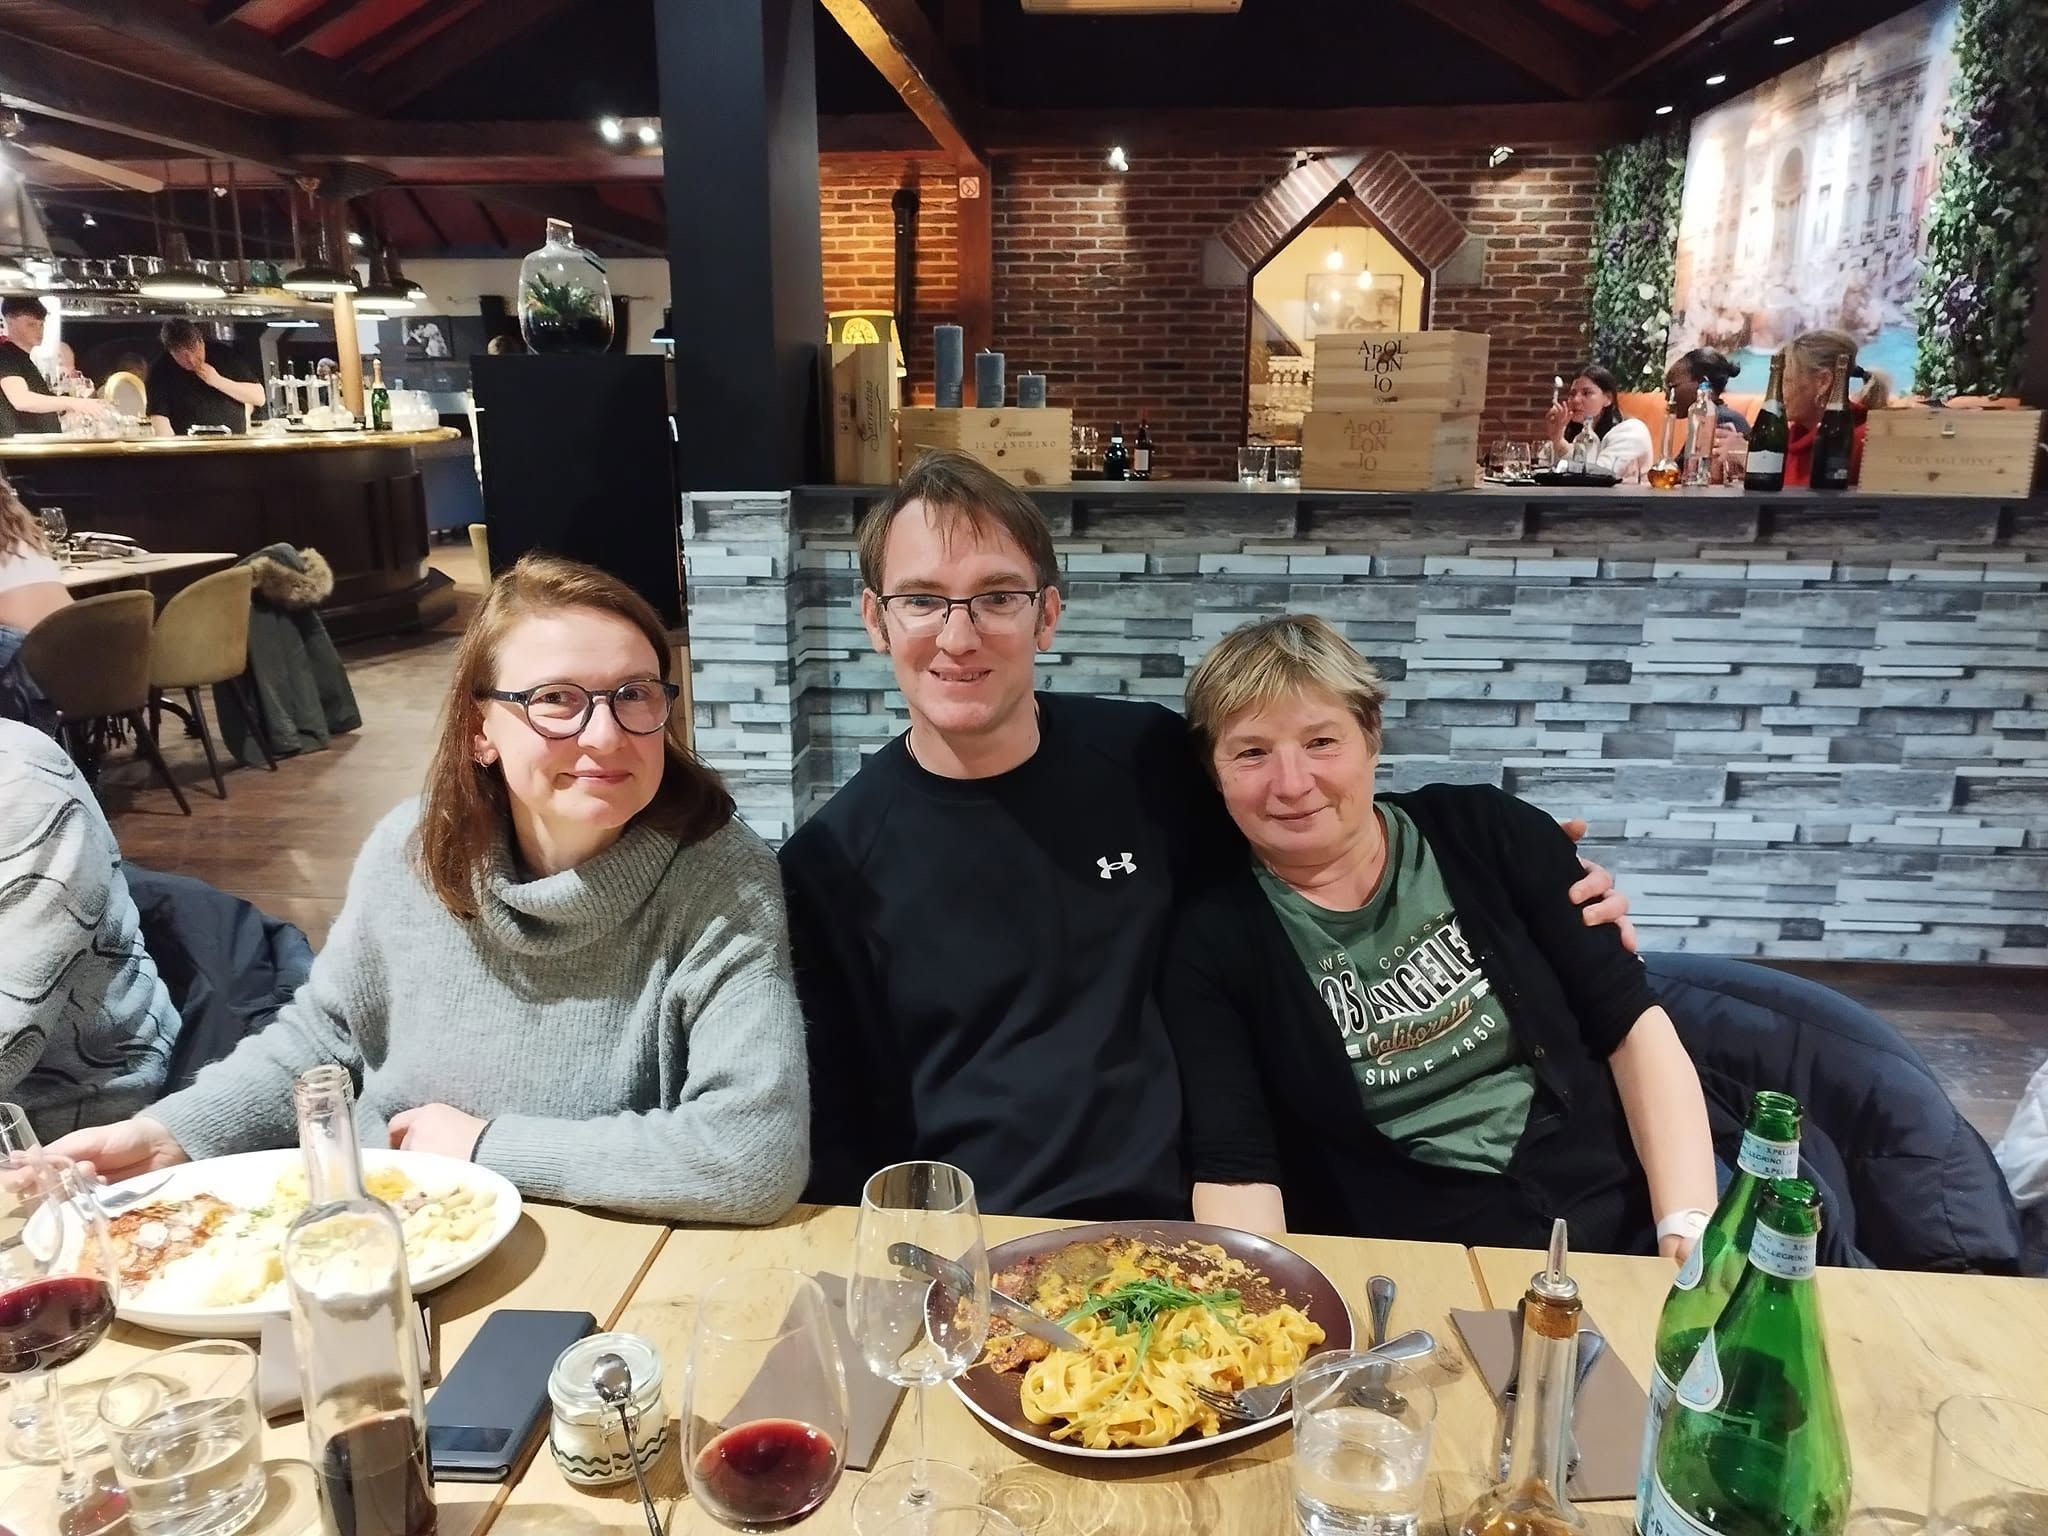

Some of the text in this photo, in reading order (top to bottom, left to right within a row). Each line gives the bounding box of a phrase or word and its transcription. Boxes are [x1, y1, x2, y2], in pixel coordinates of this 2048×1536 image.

[1358, 339, 1409, 361] APOL
[1364, 357, 1402, 374] LON
[1374, 374, 1393, 393] IO
[1350, 436, 1388, 454] LON
[1367, 995, 1473, 1066] California
[1451, 1013, 1496, 1058] 1850
